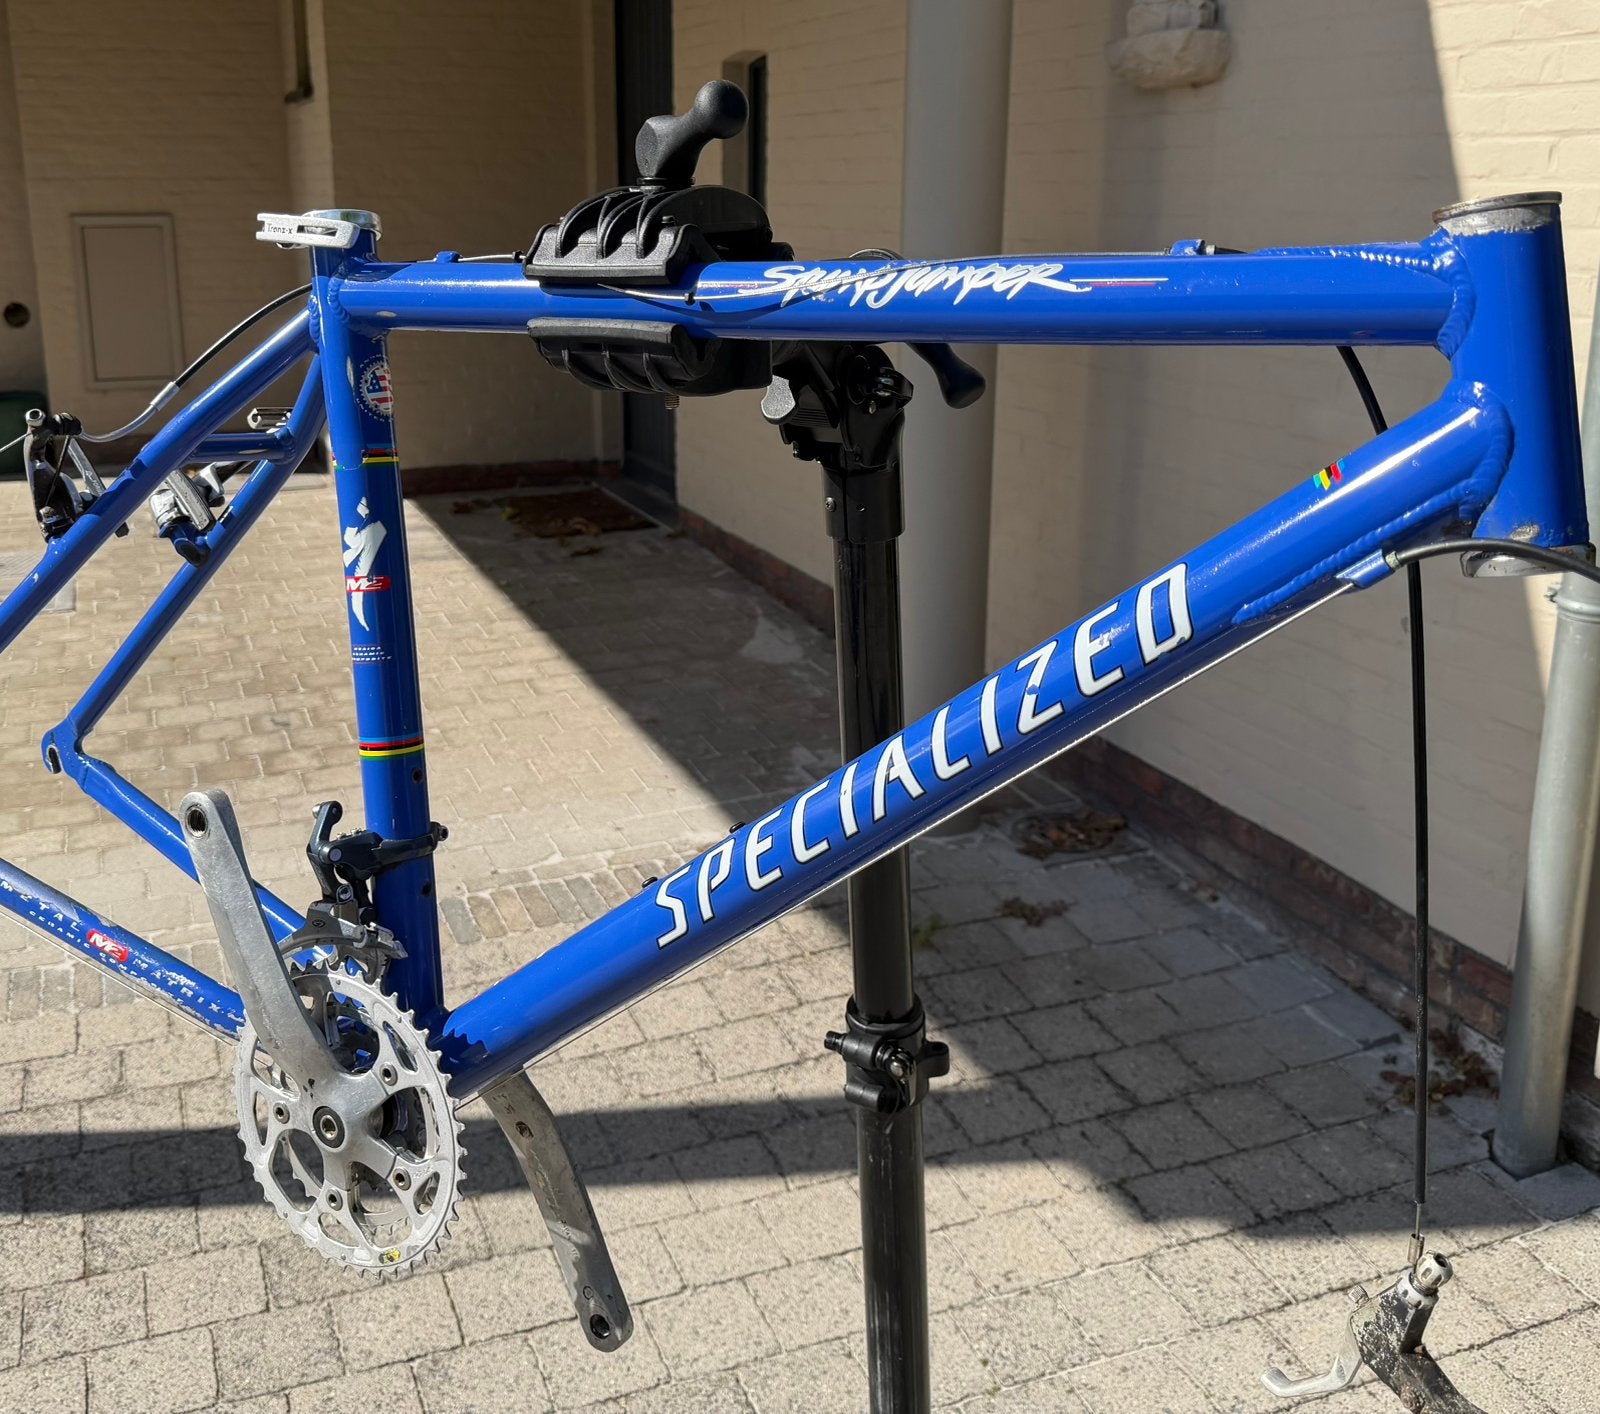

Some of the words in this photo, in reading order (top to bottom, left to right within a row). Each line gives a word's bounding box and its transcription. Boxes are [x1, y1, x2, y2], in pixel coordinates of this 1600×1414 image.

[656, 561, 1195, 950] SPECIALIZED
[0, 880, 80, 932] METAL
[132, 957, 222, 1014] MATRIX
[29, 910, 91, 949] CERAMIC
